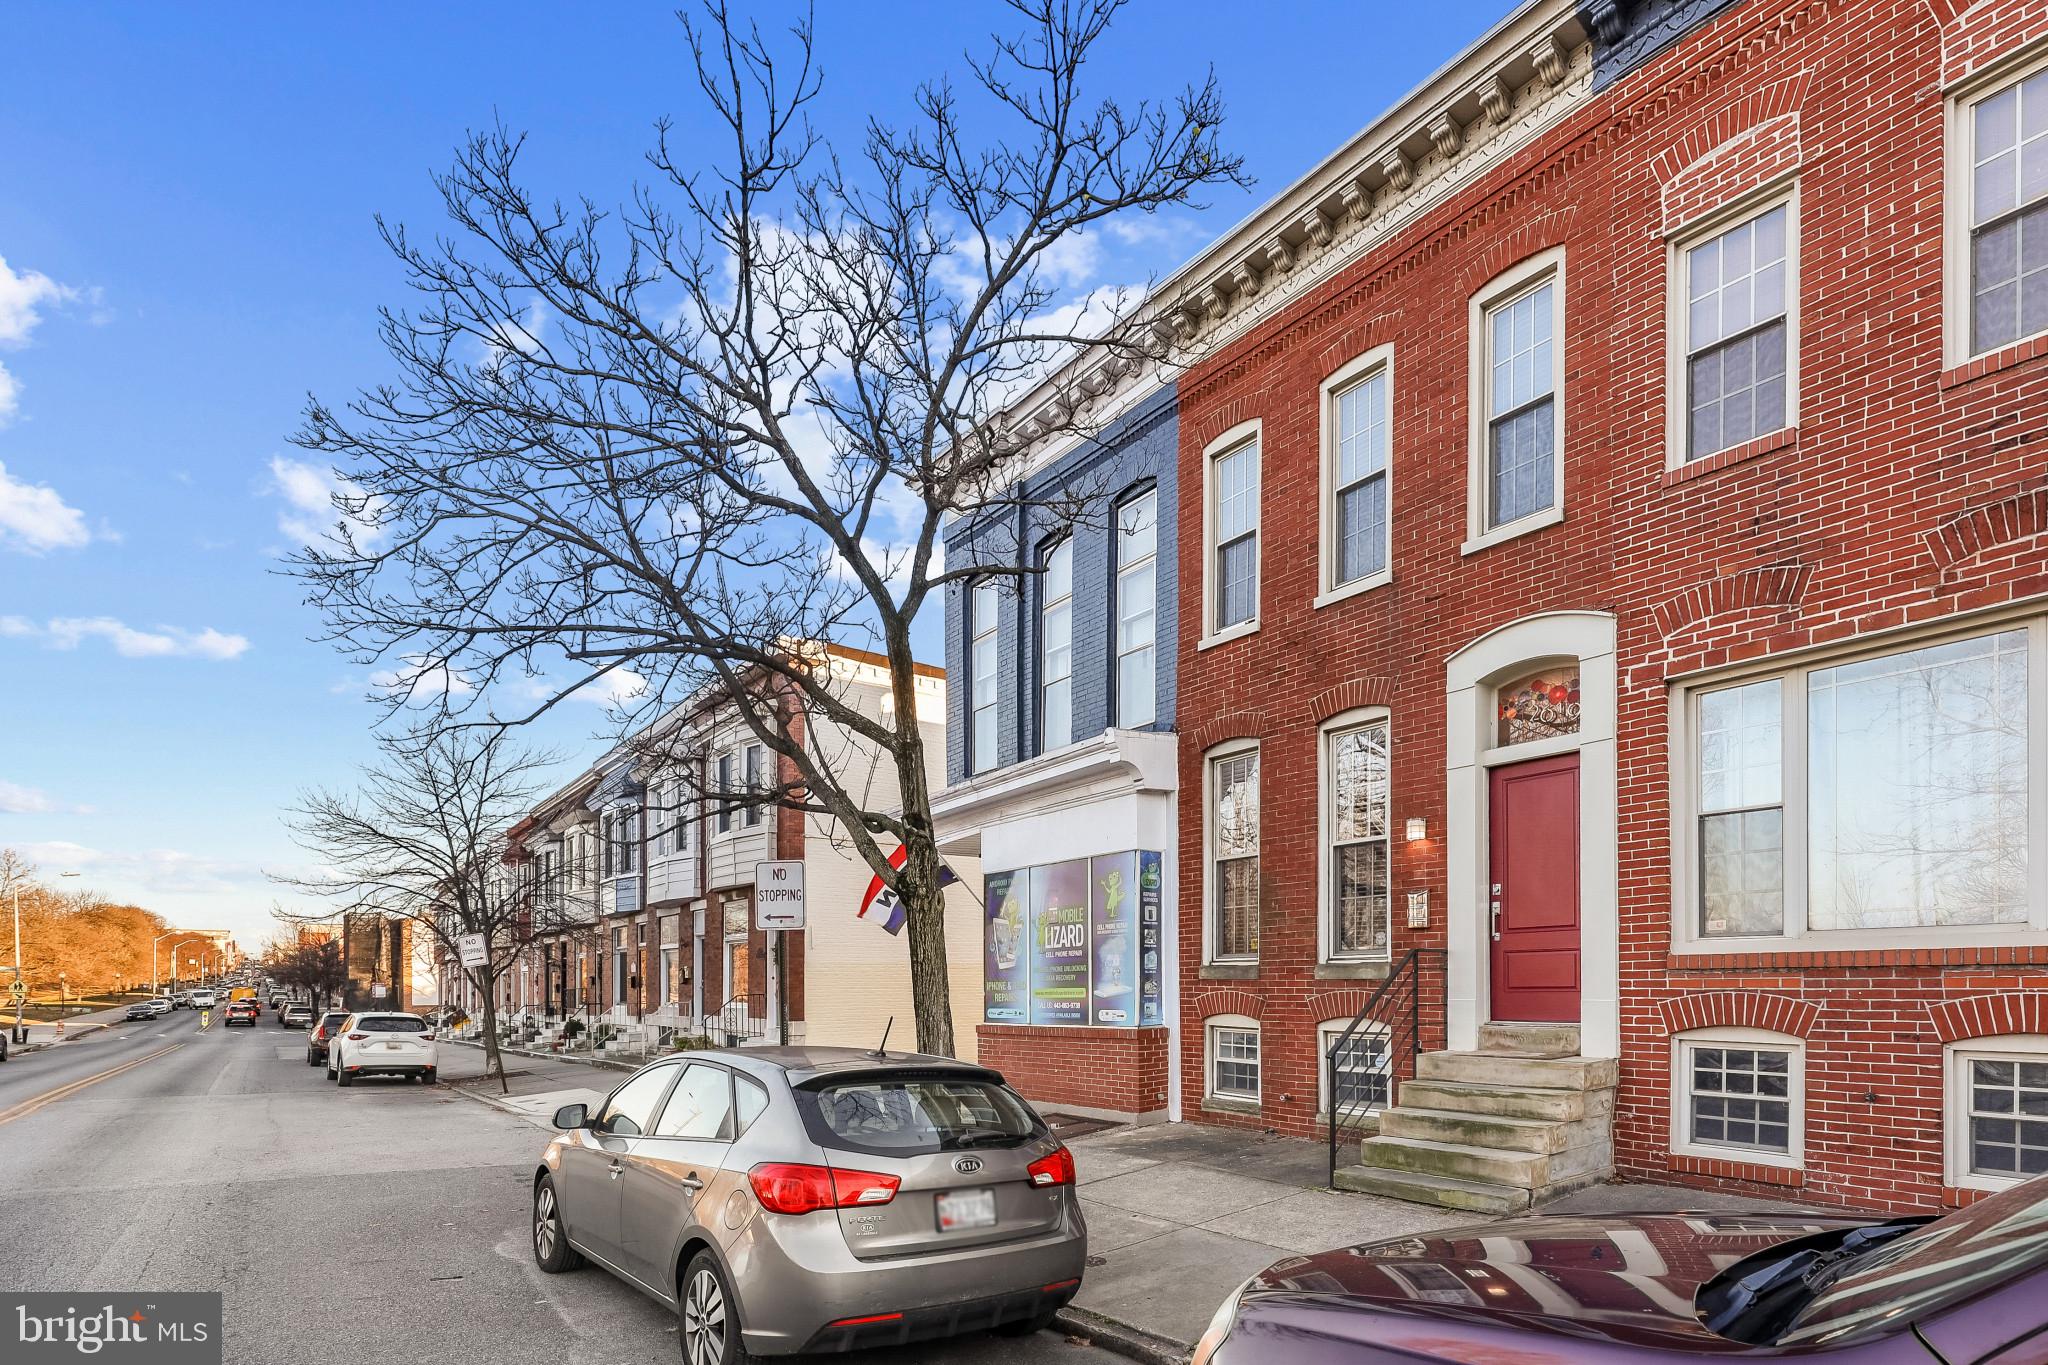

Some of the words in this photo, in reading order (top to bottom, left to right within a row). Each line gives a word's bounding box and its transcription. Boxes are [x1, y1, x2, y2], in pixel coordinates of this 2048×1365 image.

[1529, 701, 1580, 723] 2619
[772, 868, 787, 881] NO
[758, 889, 802, 902] STOPPING
[1058, 907, 1084, 923] MOBILE
[1045, 923, 1084, 949] LIZARD
[465, 938, 476, 946] NO
[462, 947, 483, 956] STOPPING
[1055, 950, 1068, 958] PHONE
[1068, 949, 1083, 957] REPAIR
[986, 981, 1007, 991] IPHONE
[960, 1162, 979, 1171] KIA
